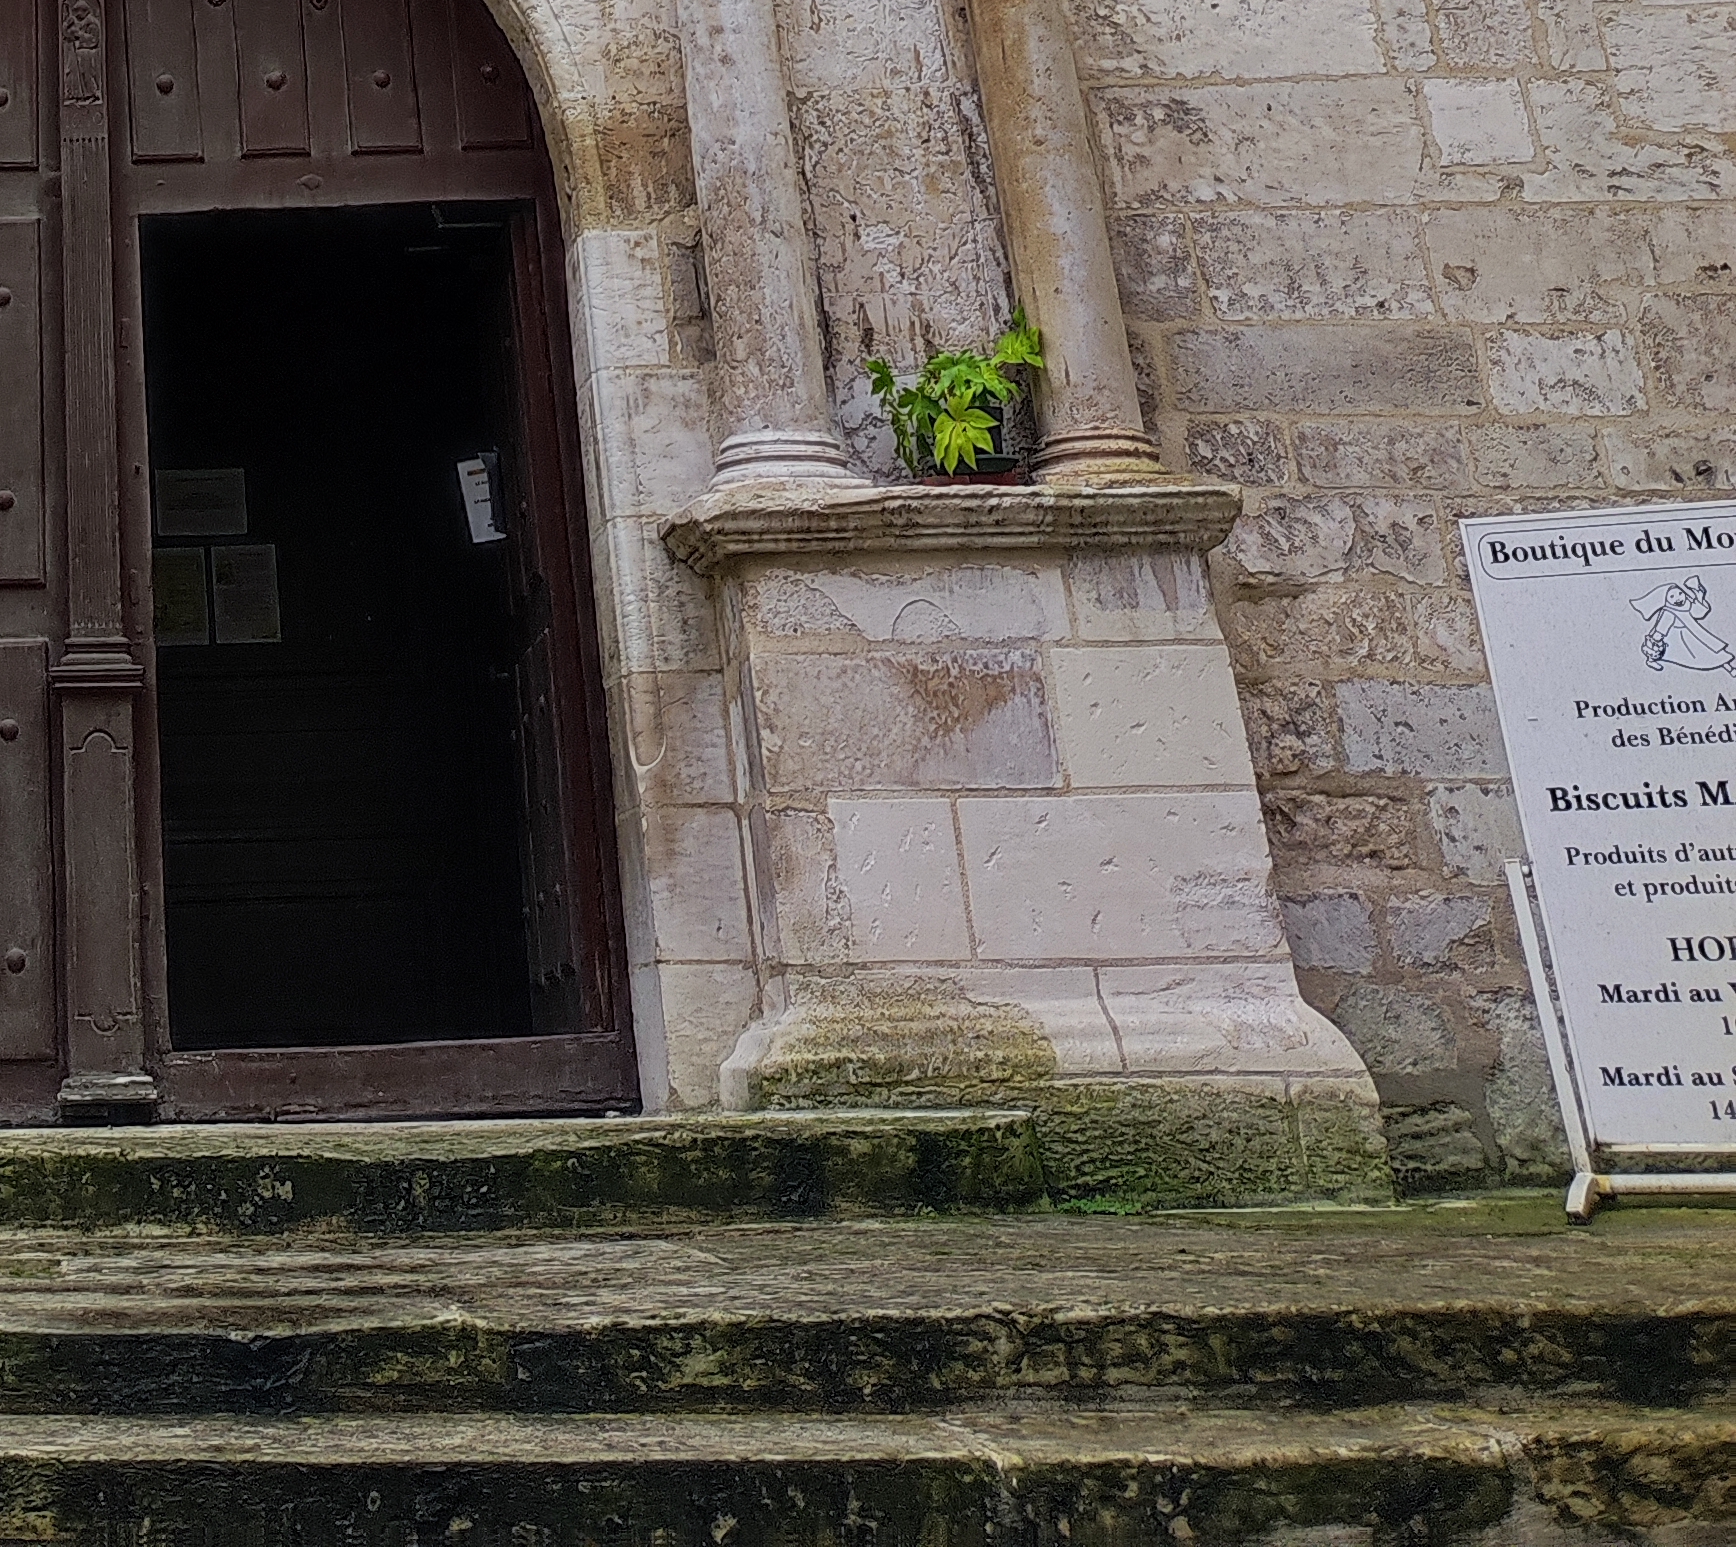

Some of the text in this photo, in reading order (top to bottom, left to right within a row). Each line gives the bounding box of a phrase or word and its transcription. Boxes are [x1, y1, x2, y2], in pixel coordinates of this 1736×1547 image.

[1487, 526, 1736, 567] Boutique du Mo
[1573, 695, 1707, 719] Production
[1611, 728, 1651, 748] des
[1546, 781, 1689, 813] Biscuits
[1564, 844, 1668, 866] Produits
[1614, 873, 1736, 903] et produit
[1597, 981, 1682, 1004] Mardi
[1689, 988, 1723, 1003] au
[1599, 1065, 1684, 1087] Mardi
[1691, 1072, 1725, 1087] au
